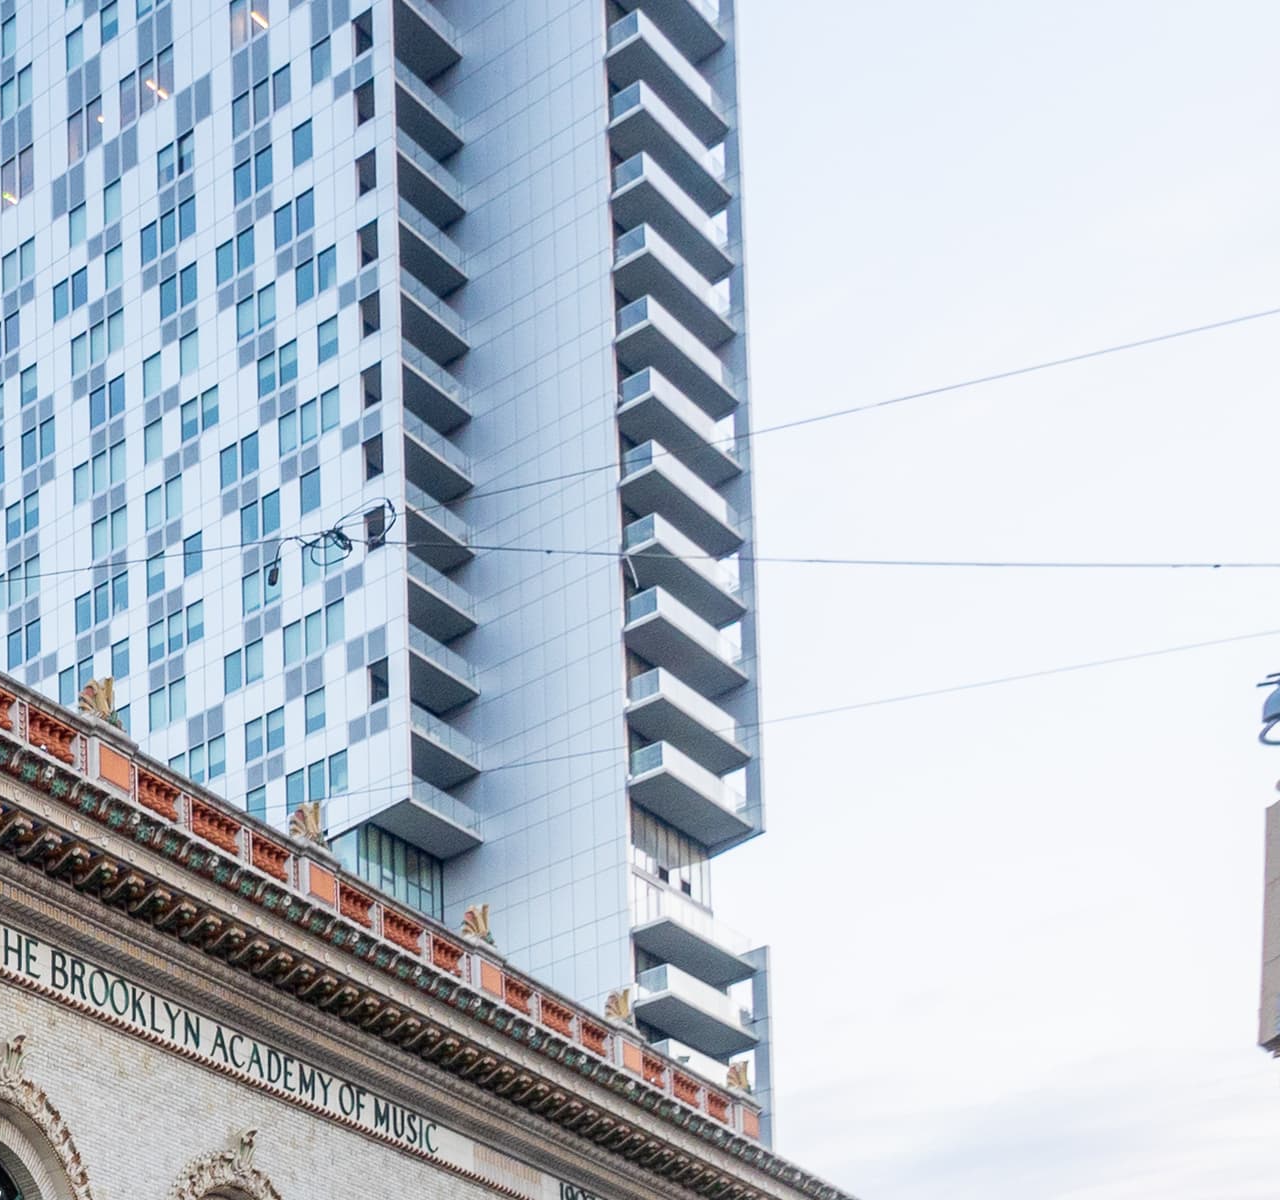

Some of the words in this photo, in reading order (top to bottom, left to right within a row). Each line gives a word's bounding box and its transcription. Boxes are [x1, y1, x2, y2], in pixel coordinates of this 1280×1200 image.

[50, 950, 201, 1050] BROOKLYN
[210, 1026, 334, 1105] ACADEMY
[338, 1082, 366, 1121] OF
[372, 1097, 440, 1154] MUSIC
